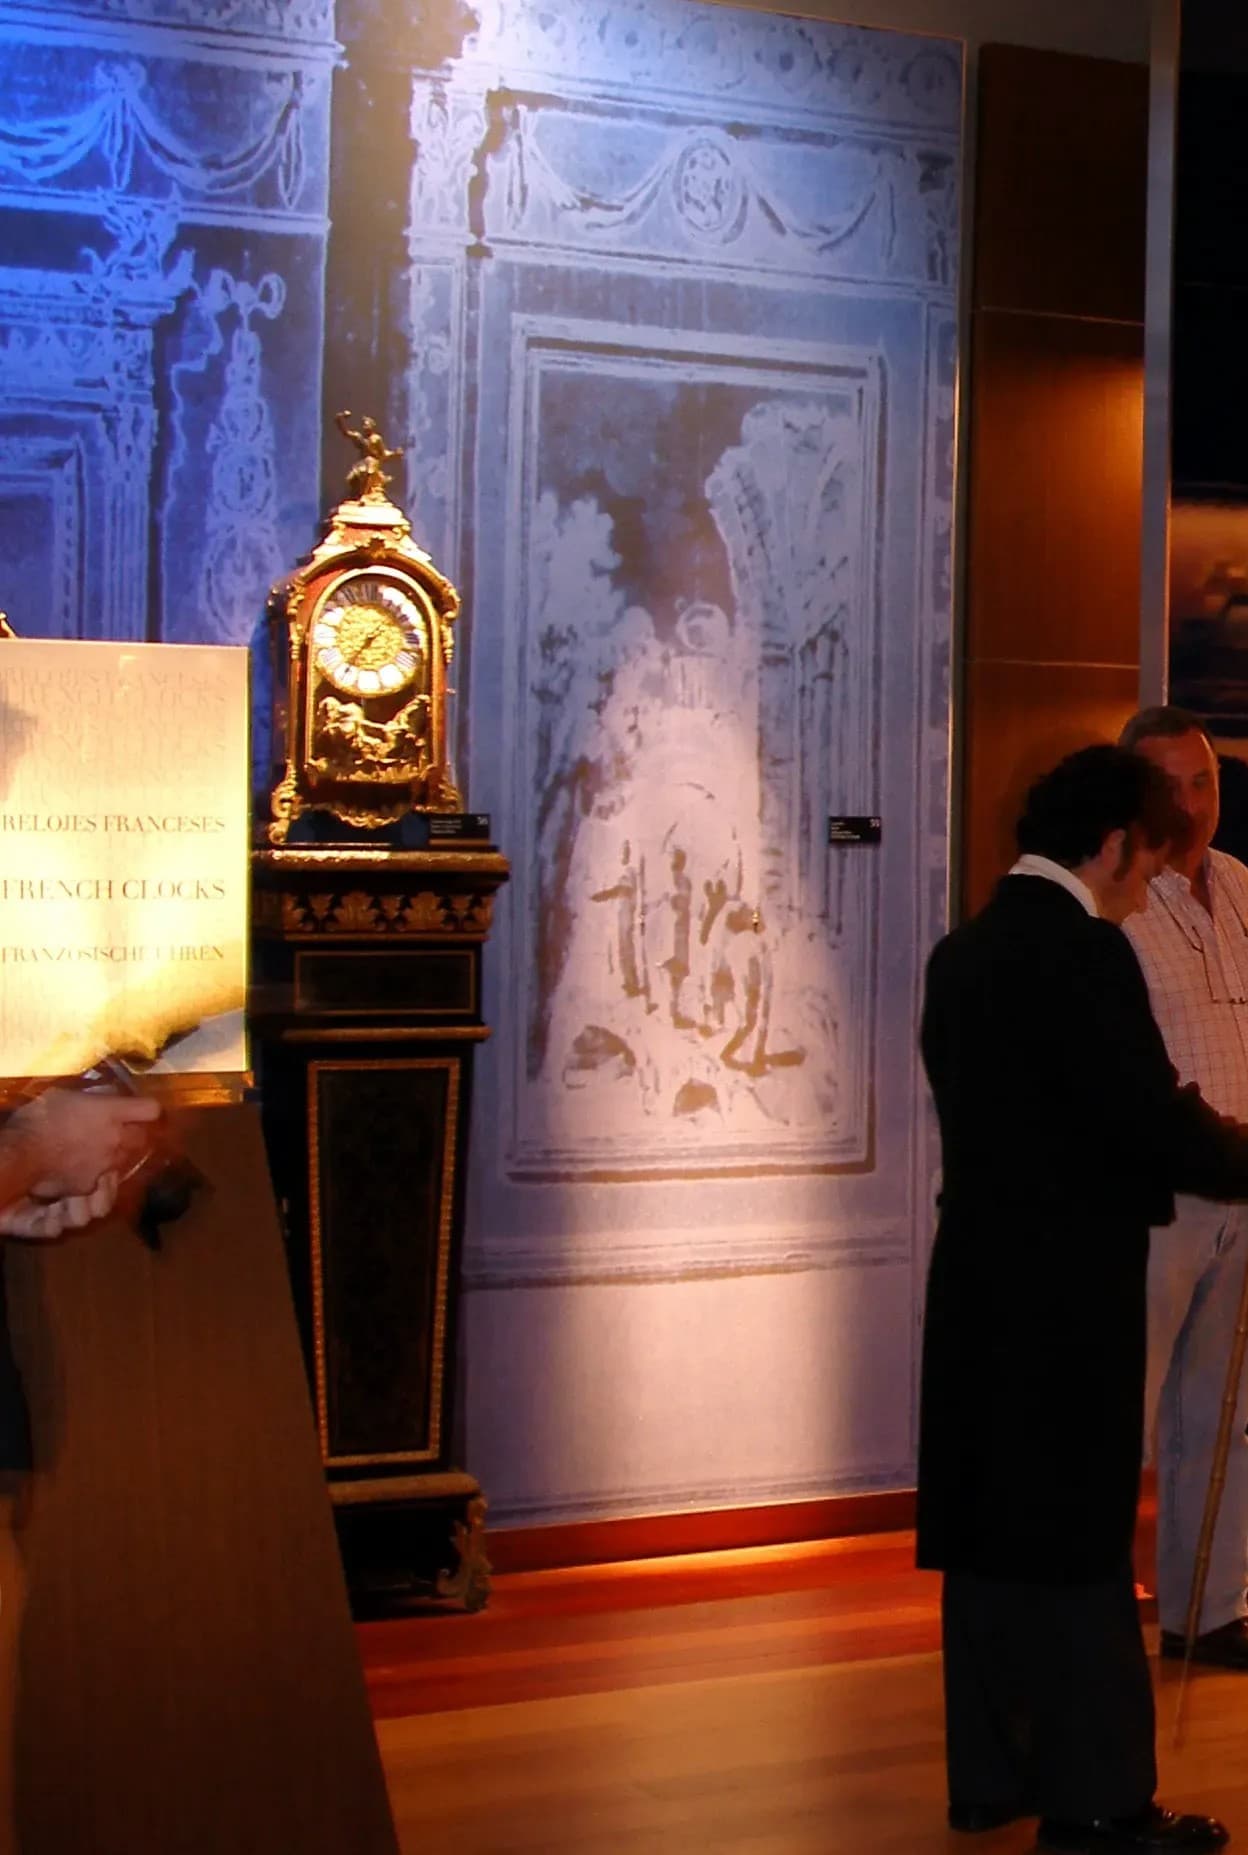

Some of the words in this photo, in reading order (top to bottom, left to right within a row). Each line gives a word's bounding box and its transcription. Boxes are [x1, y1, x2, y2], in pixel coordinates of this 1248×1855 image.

[2, 815, 97, 832] RELOJES
[103, 815, 225, 832] FRANCESES
[2, 879, 114, 900] FRENCH
[121, 879, 225, 900] CLOCKS
